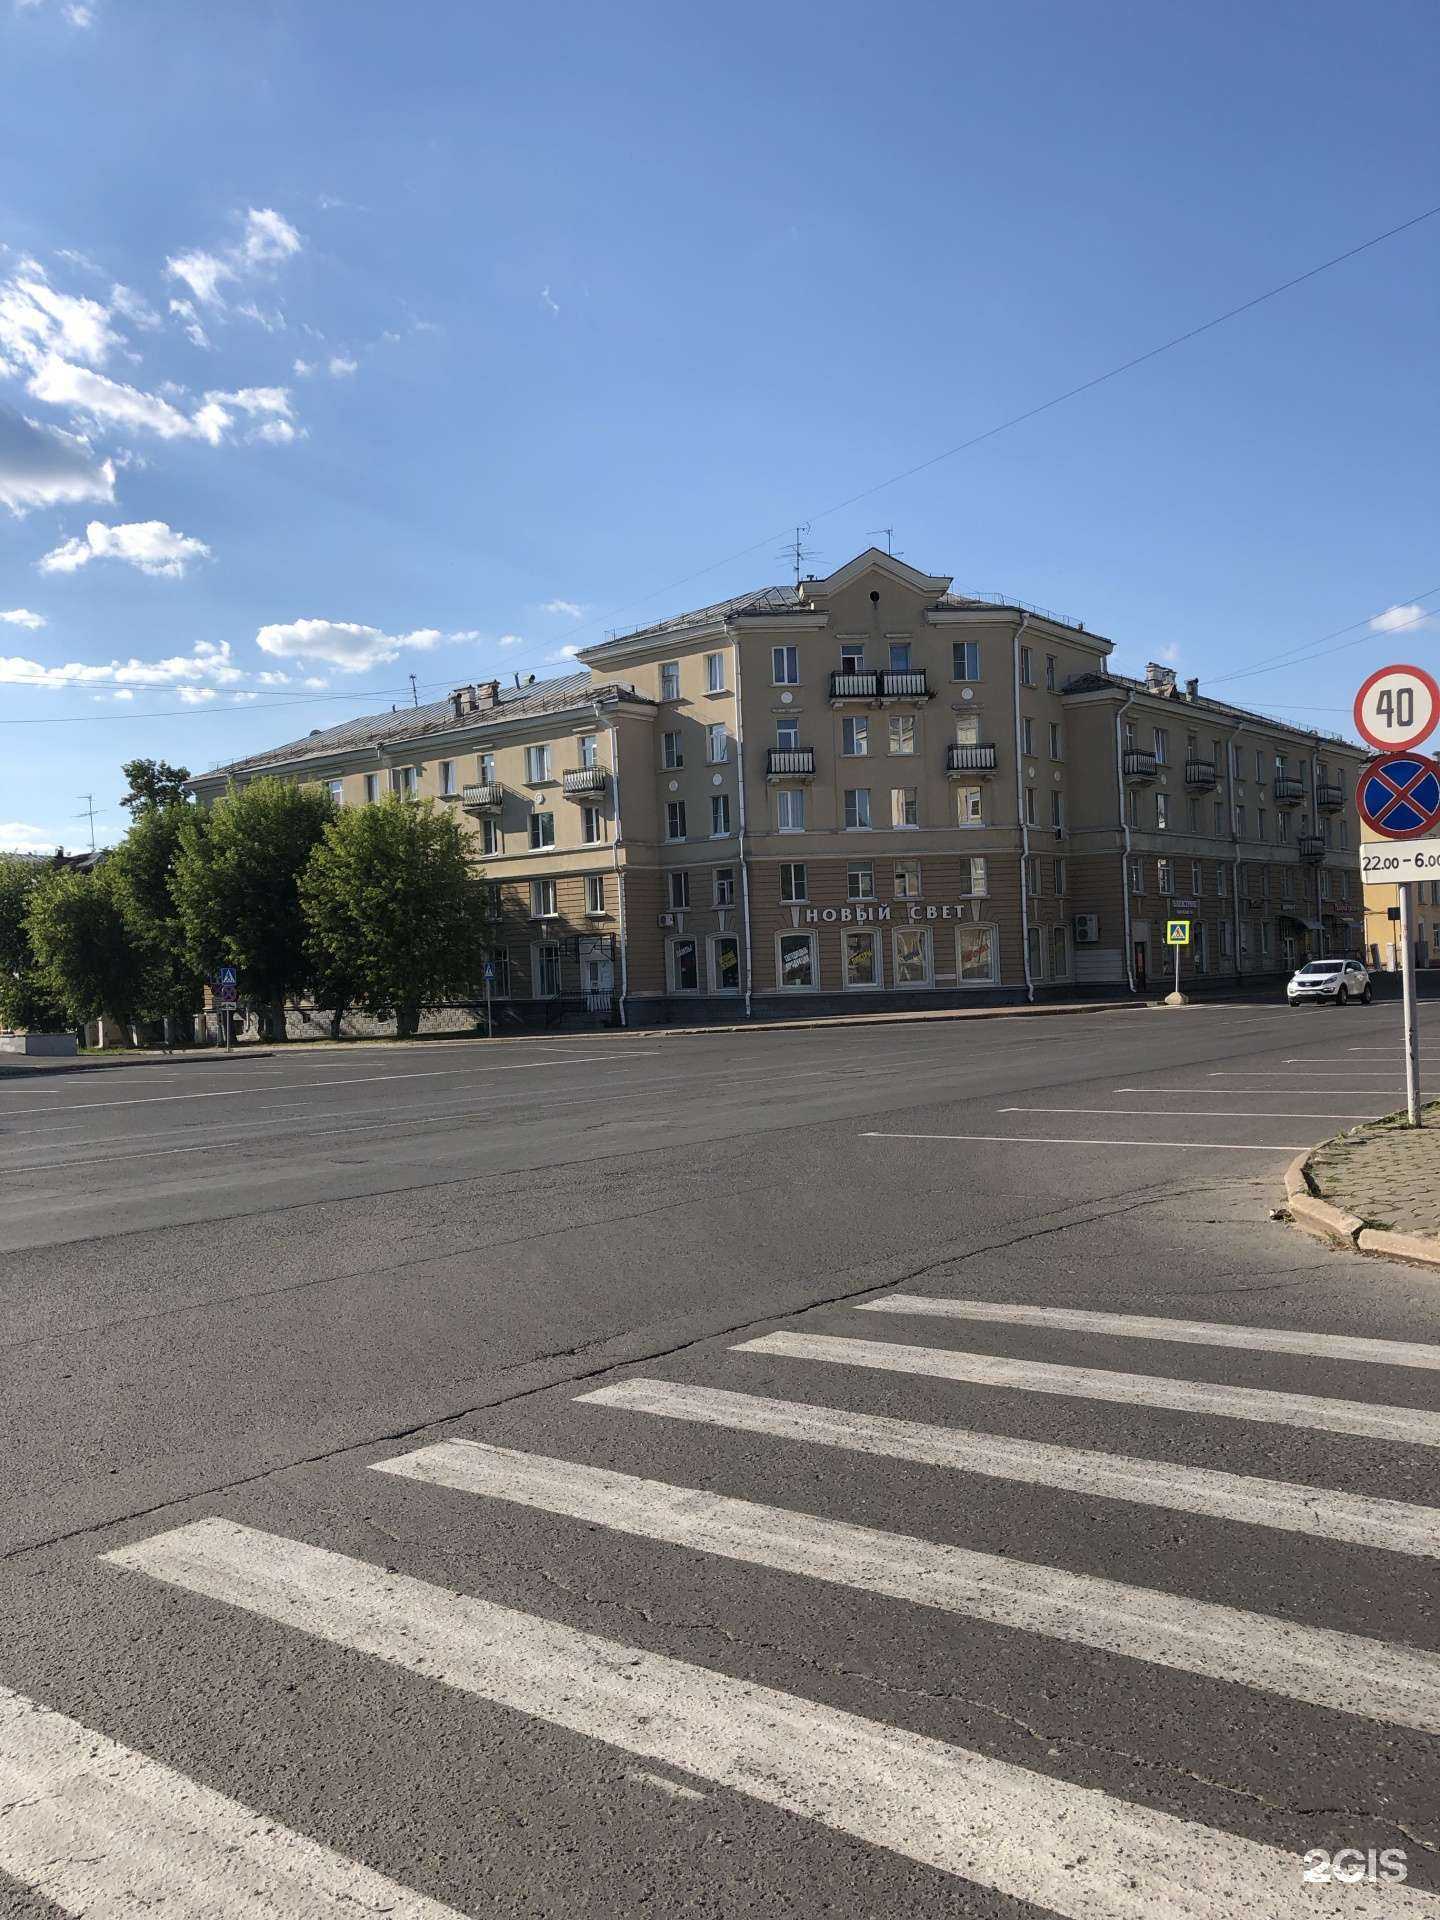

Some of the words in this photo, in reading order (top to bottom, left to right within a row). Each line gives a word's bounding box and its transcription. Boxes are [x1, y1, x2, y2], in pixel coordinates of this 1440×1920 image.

[1376, 687, 1414, 728] 40
[806, 904, 891, 922] НОВЫЙ
[910, 904, 965, 919] СВЕТ
